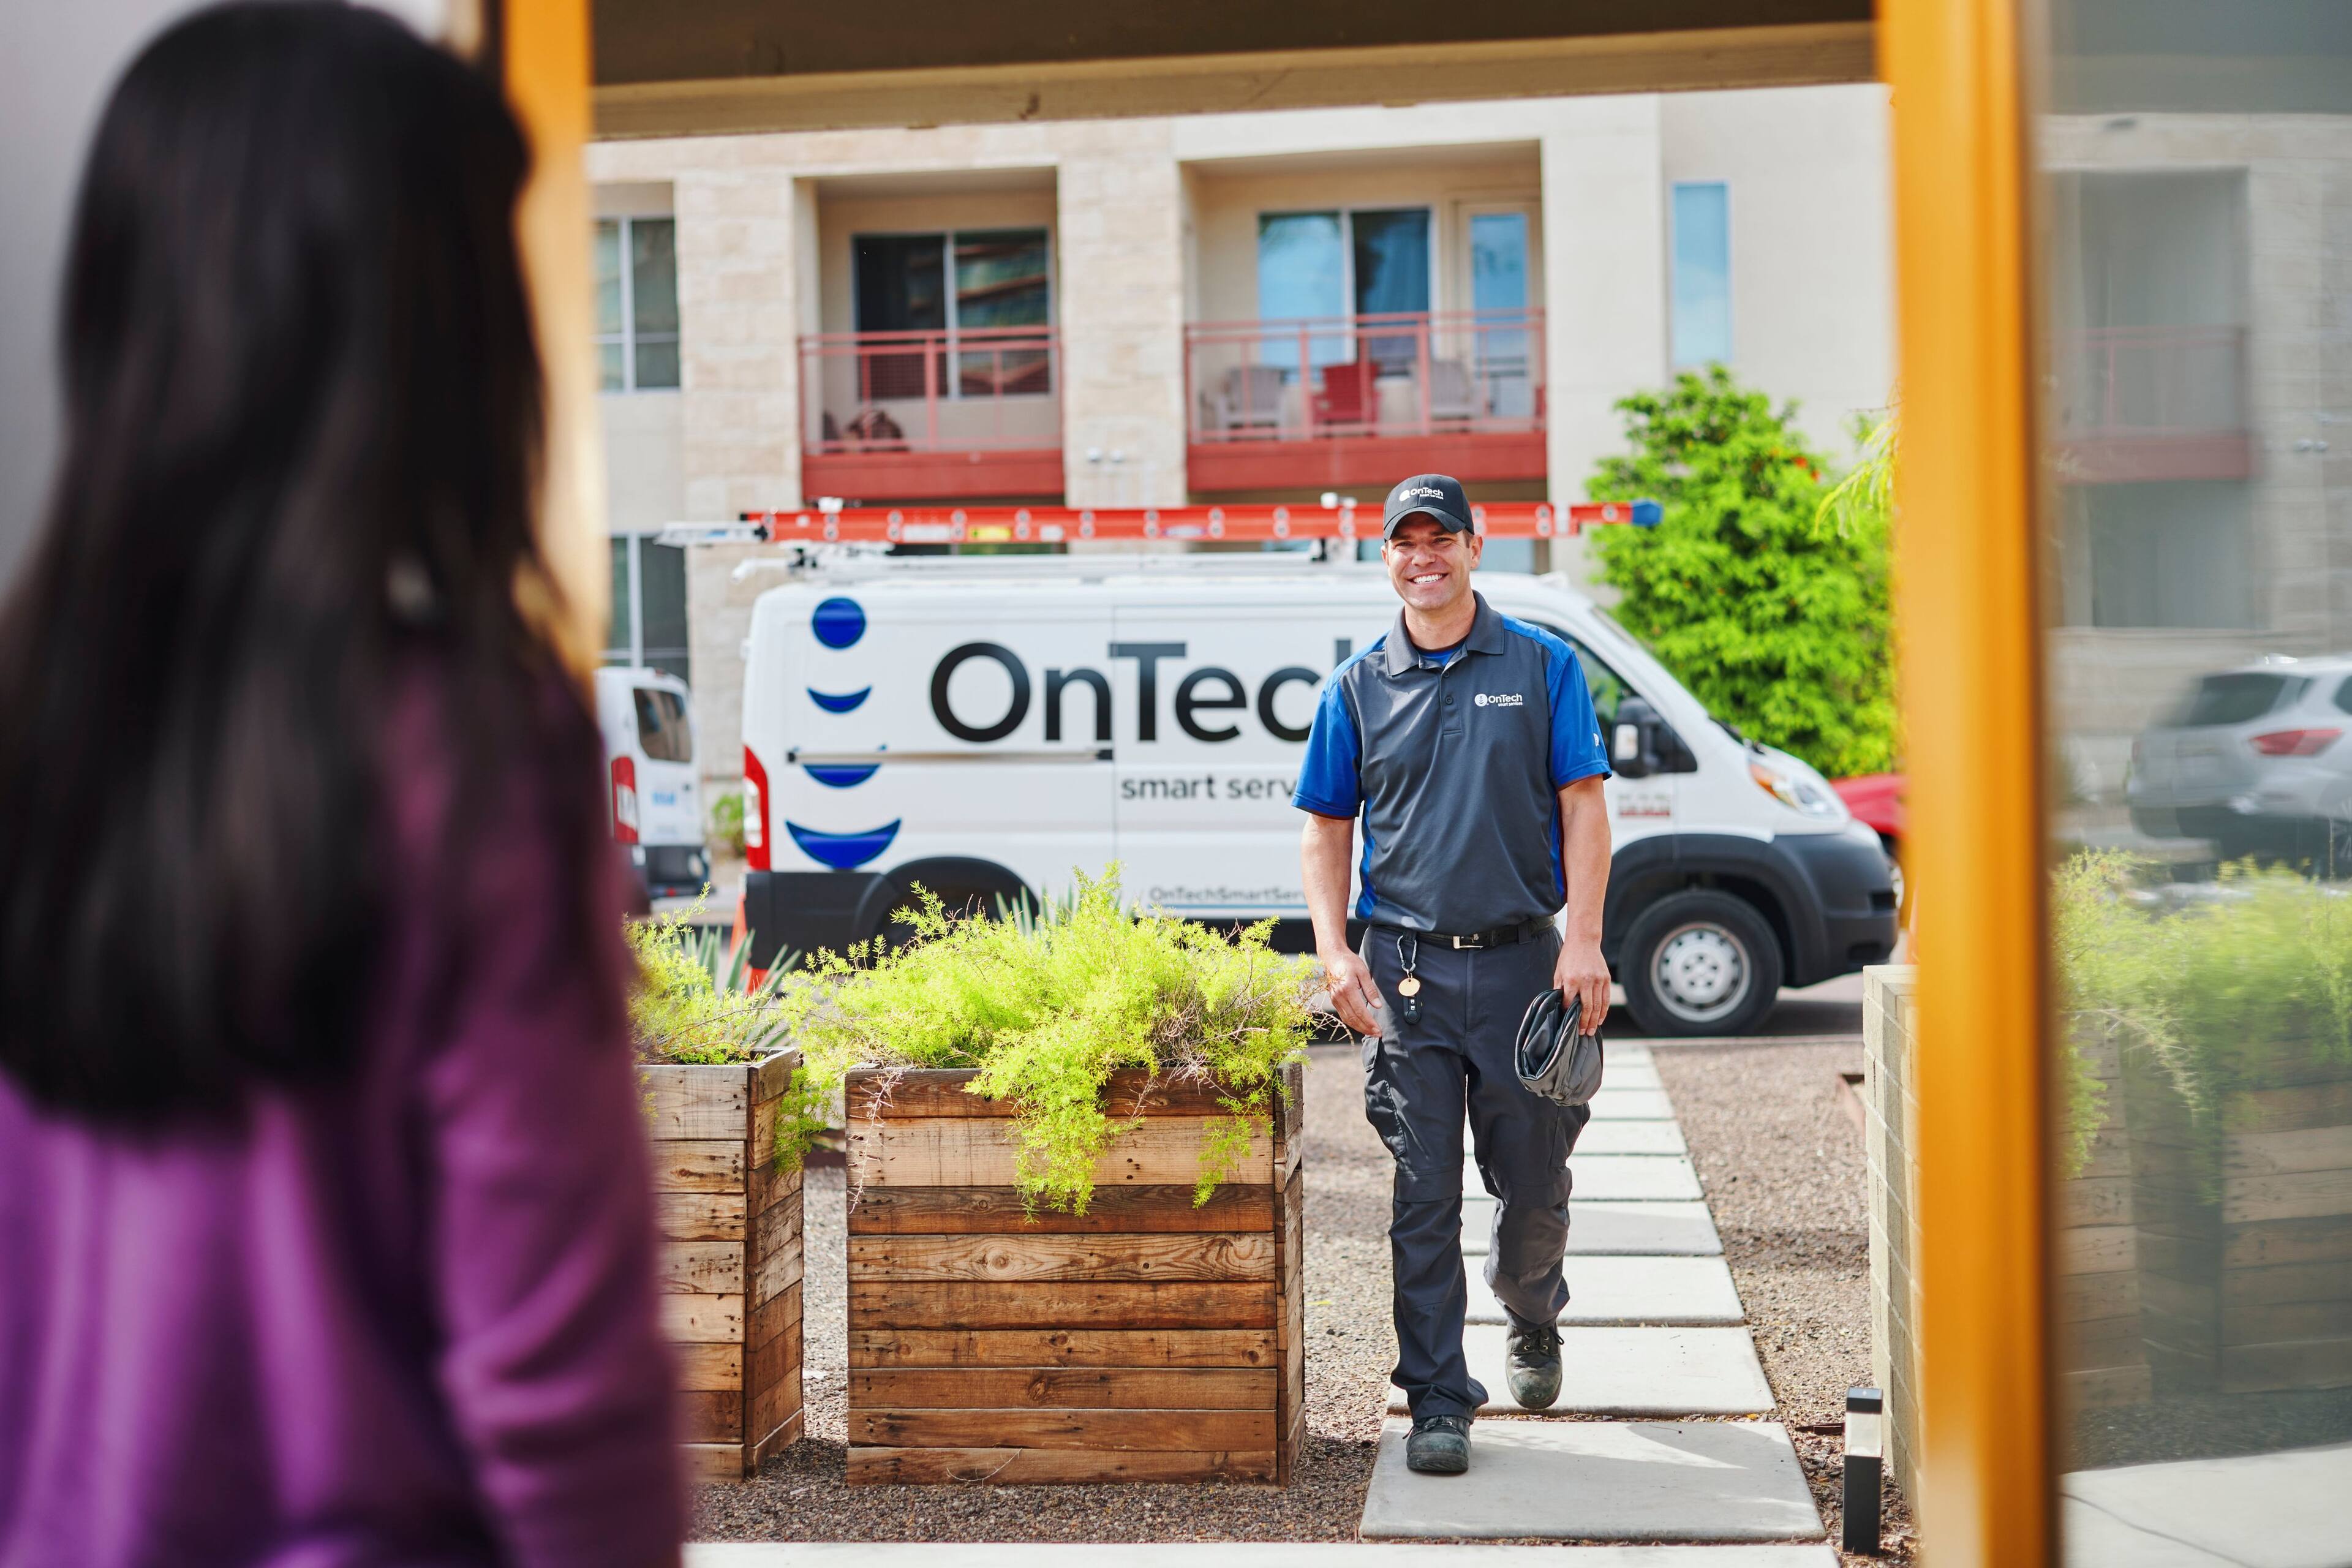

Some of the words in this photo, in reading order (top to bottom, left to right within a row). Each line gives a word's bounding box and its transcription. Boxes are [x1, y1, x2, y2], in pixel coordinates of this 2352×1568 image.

[1411, 487, 1444, 497] OnTech
[930, 639, 1352, 742] OnTec
[1488, 693, 1522, 703] OnTech
[1121, 774, 1215, 799] smart
[1227, 777, 1298, 800] serv
